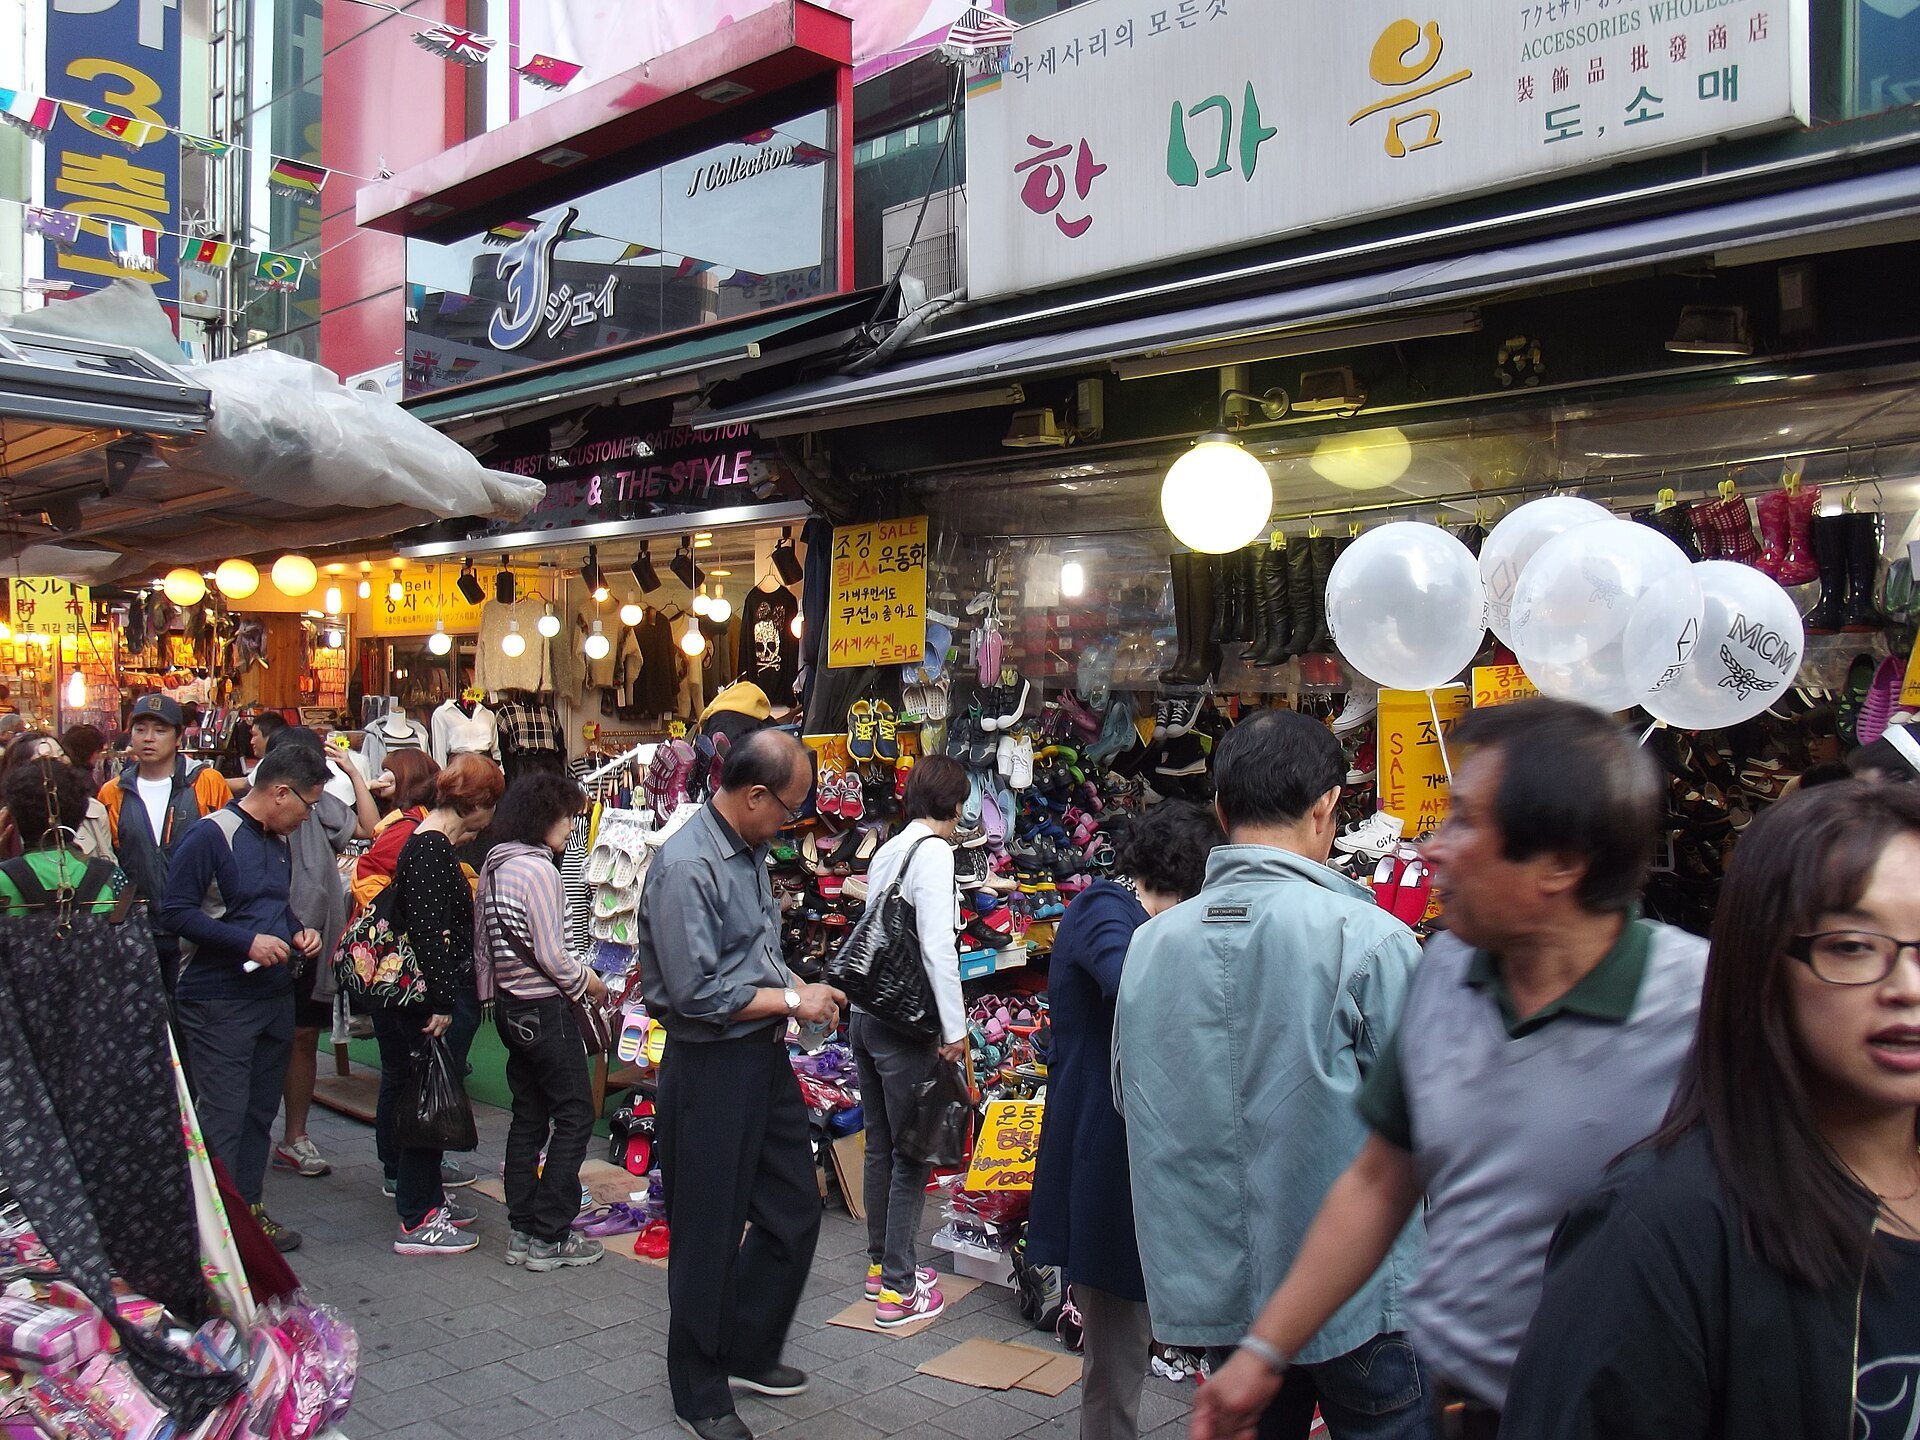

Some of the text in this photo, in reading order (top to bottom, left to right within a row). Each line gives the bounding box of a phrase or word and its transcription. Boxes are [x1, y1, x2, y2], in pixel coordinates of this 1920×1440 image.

[1014, 19, 1134, 83] 악세사리의
[1520, 10, 1641, 62] ACCESSORIES
[685, 145, 795, 198] J Collection
[545, 274, 619, 339] ジェイ
[513, 453, 546, 475] BEST
[569, 435, 641, 467] CUSTOMER
[645, 424, 750, 450] SATISFACTION
[586, 474, 603, 506] &
[616, 465, 662, 502] THE
[668, 450, 753, 494] STYLE
[835, 521, 919, 560] 조깅 SALE
[879, 542, 927, 574] 운동화
[16, 578, 83, 596] ベルト
[405, 580, 432, 592] Belt
[423, 592, 459, 608] ベルト
[840, 605, 878, 625] 쿠션이
[1706, 613, 1798, 675] MCM
[1390, 732, 1406, 811] SALE
